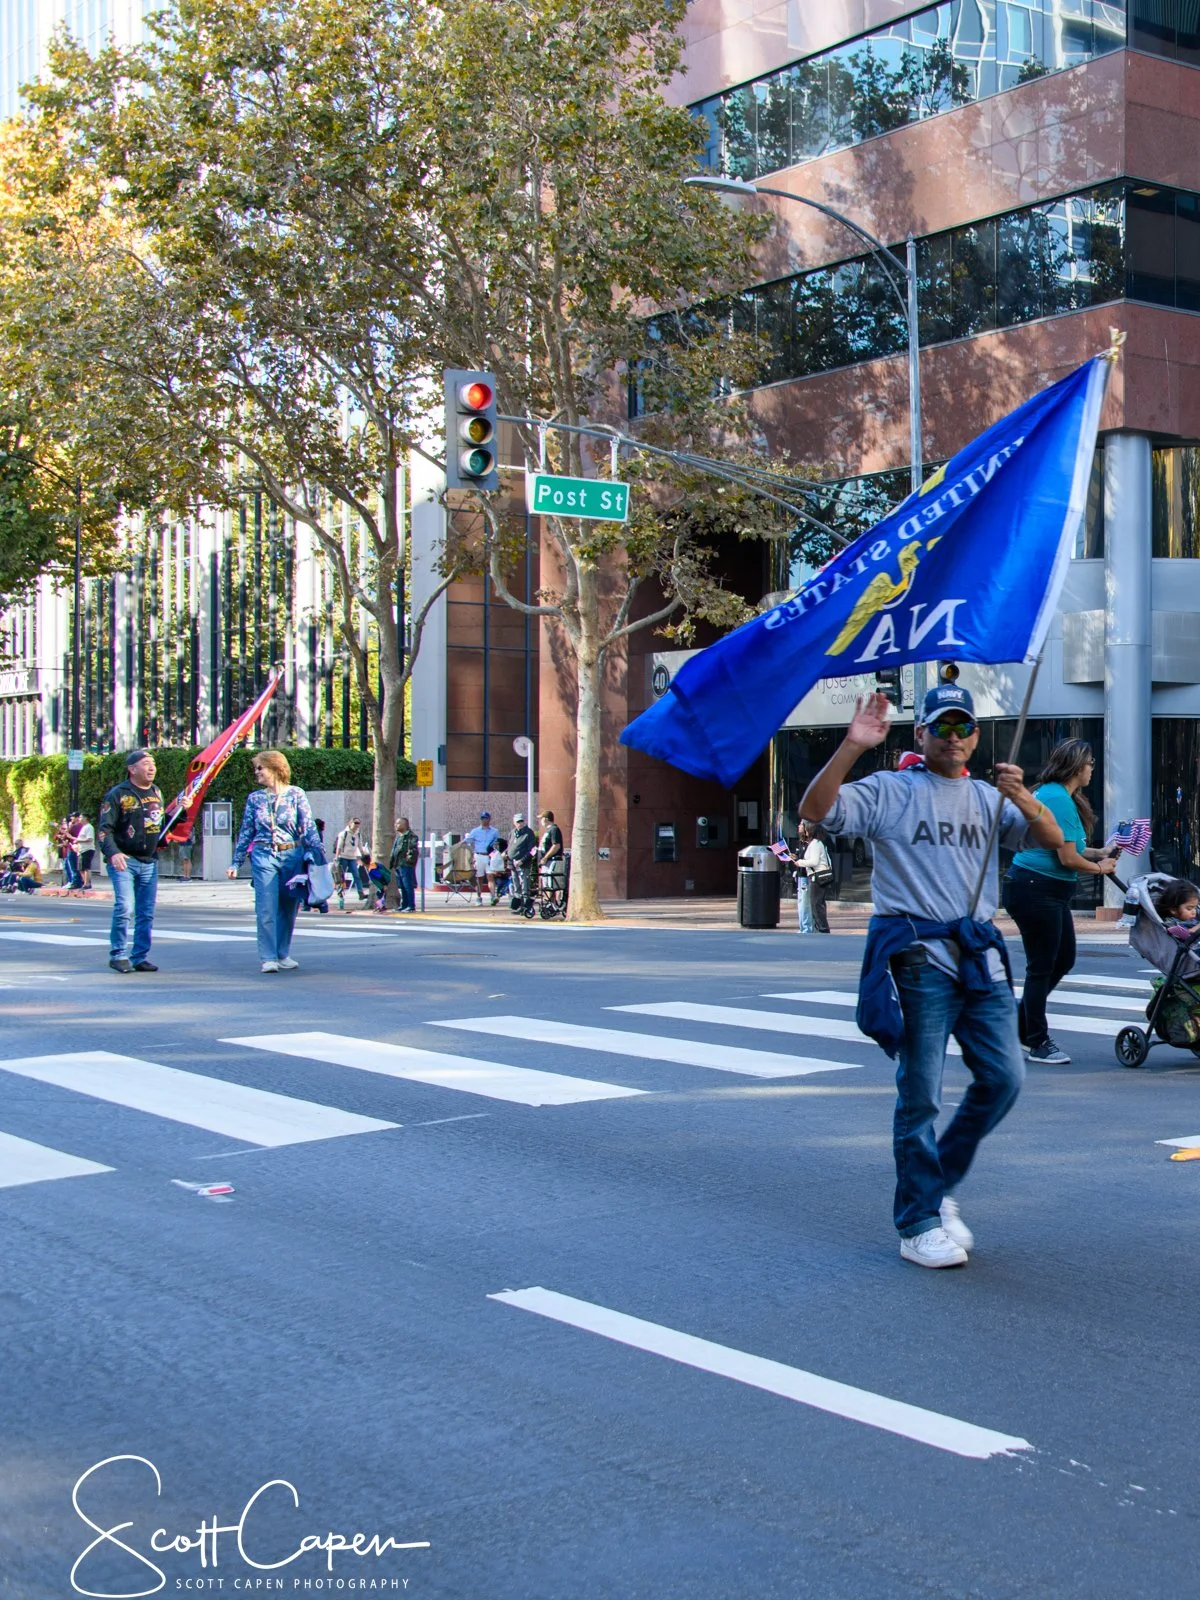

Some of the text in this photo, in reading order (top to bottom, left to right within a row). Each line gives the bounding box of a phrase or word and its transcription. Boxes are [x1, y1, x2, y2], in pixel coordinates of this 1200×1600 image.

[538, 484, 623, 511] Post St
[654, 672, 666, 690] 40
